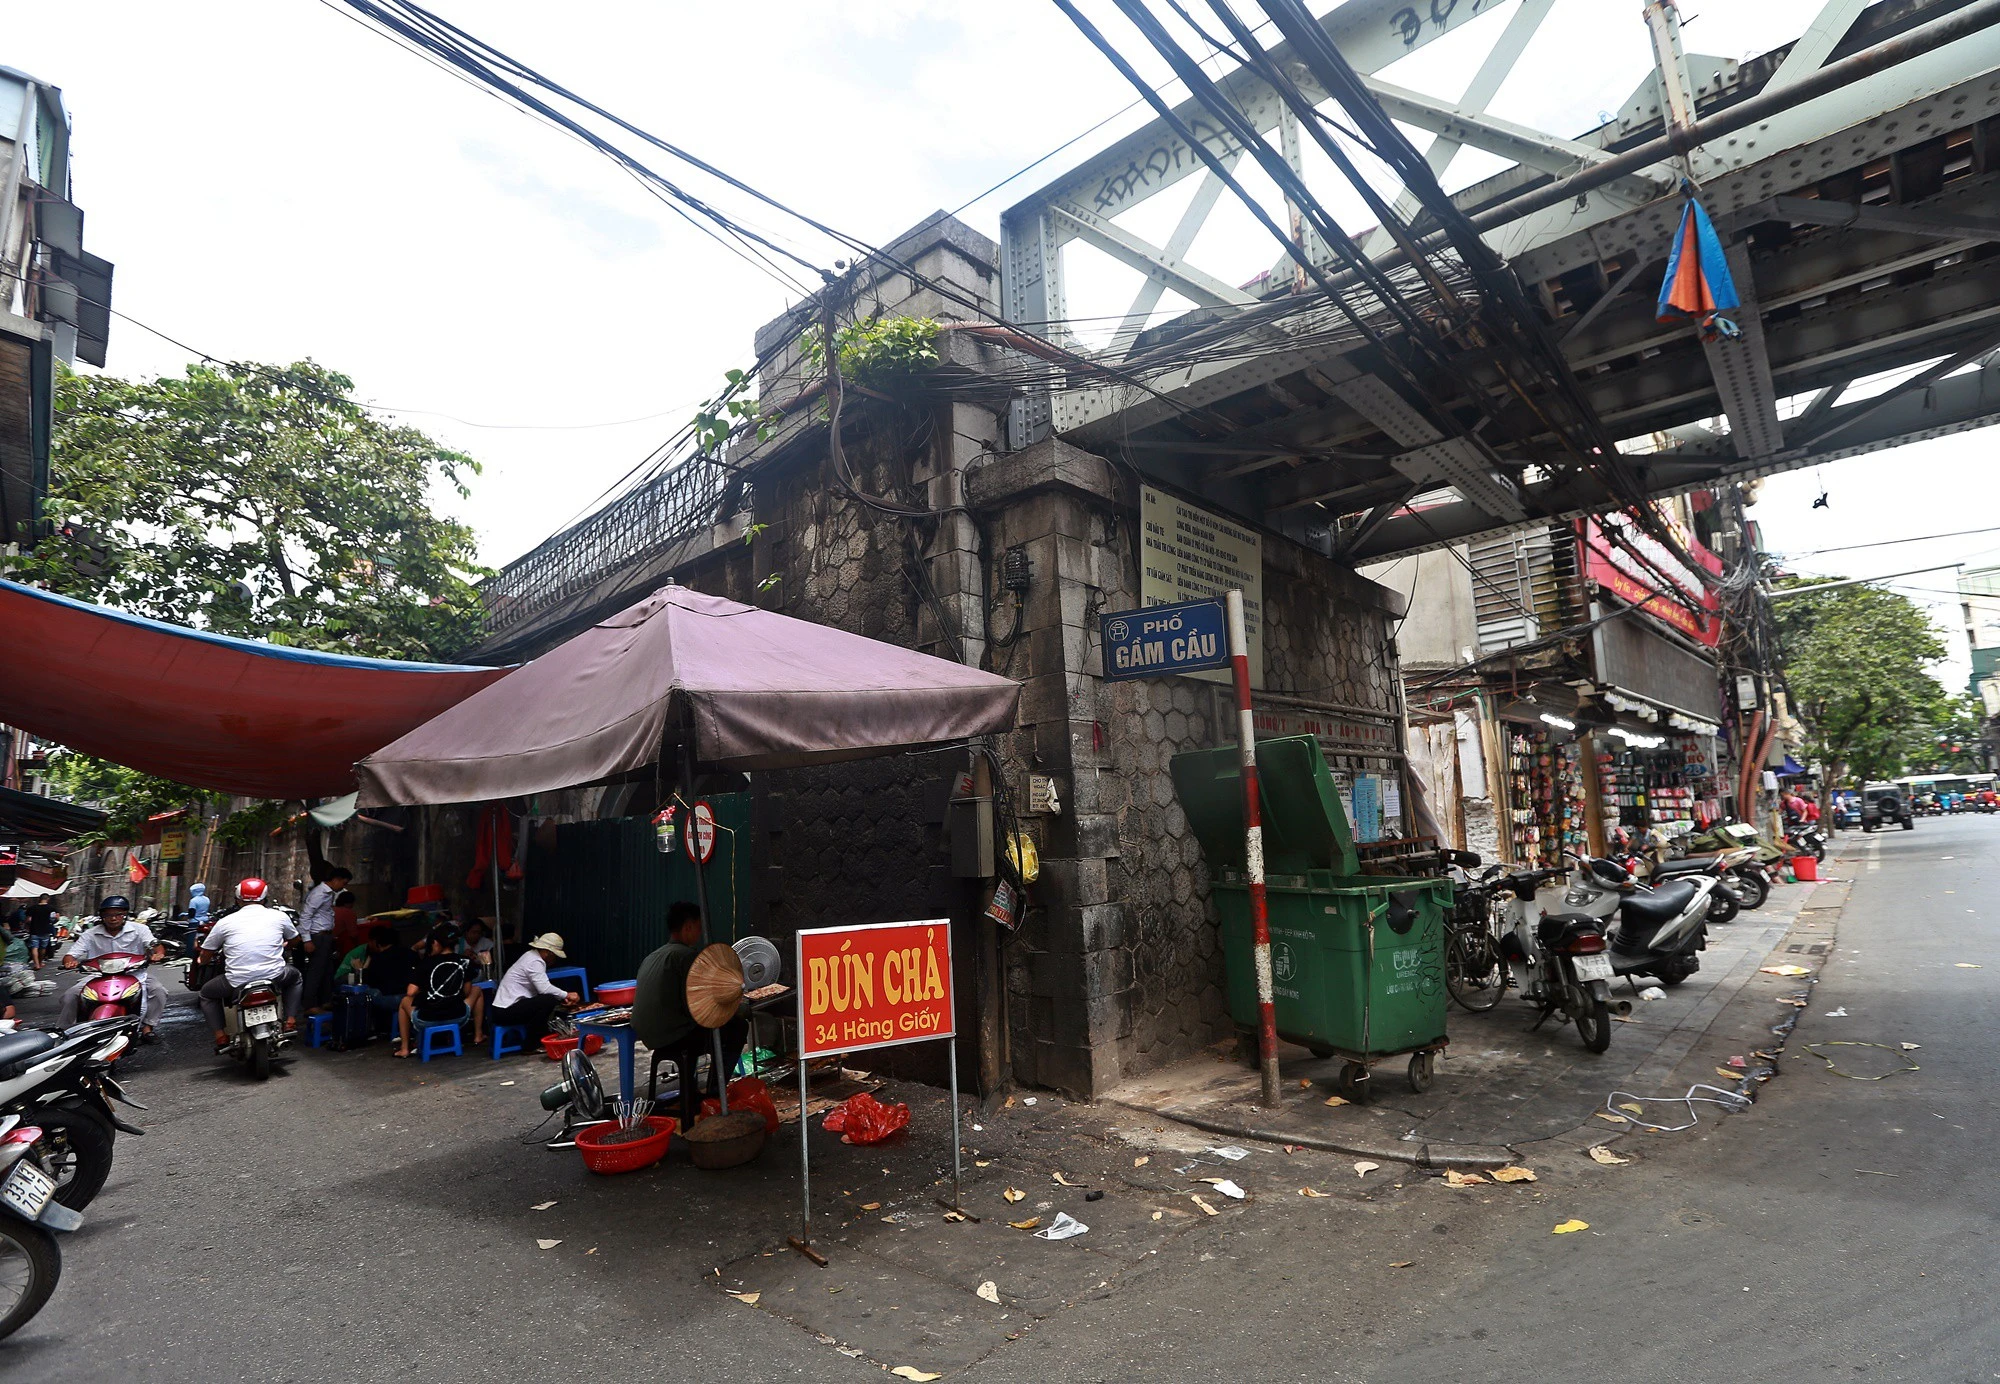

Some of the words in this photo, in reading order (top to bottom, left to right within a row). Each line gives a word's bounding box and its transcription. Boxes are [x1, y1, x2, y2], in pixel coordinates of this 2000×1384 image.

[1143, 611, 1183, 634] PHỐ
[1115, 636, 1165, 669] GẦM
[1171, 628, 1217, 662] CẦU
[808, 939, 874, 1015] BÚN
[883, 928, 944, 1006] CHẢ
[815, 1023, 838, 1044] 34
[843, 1017, 894, 1040] Hàng
[900, 1006, 941, 1032] Giấy
[22, 1178, 51, 1213] 7047
